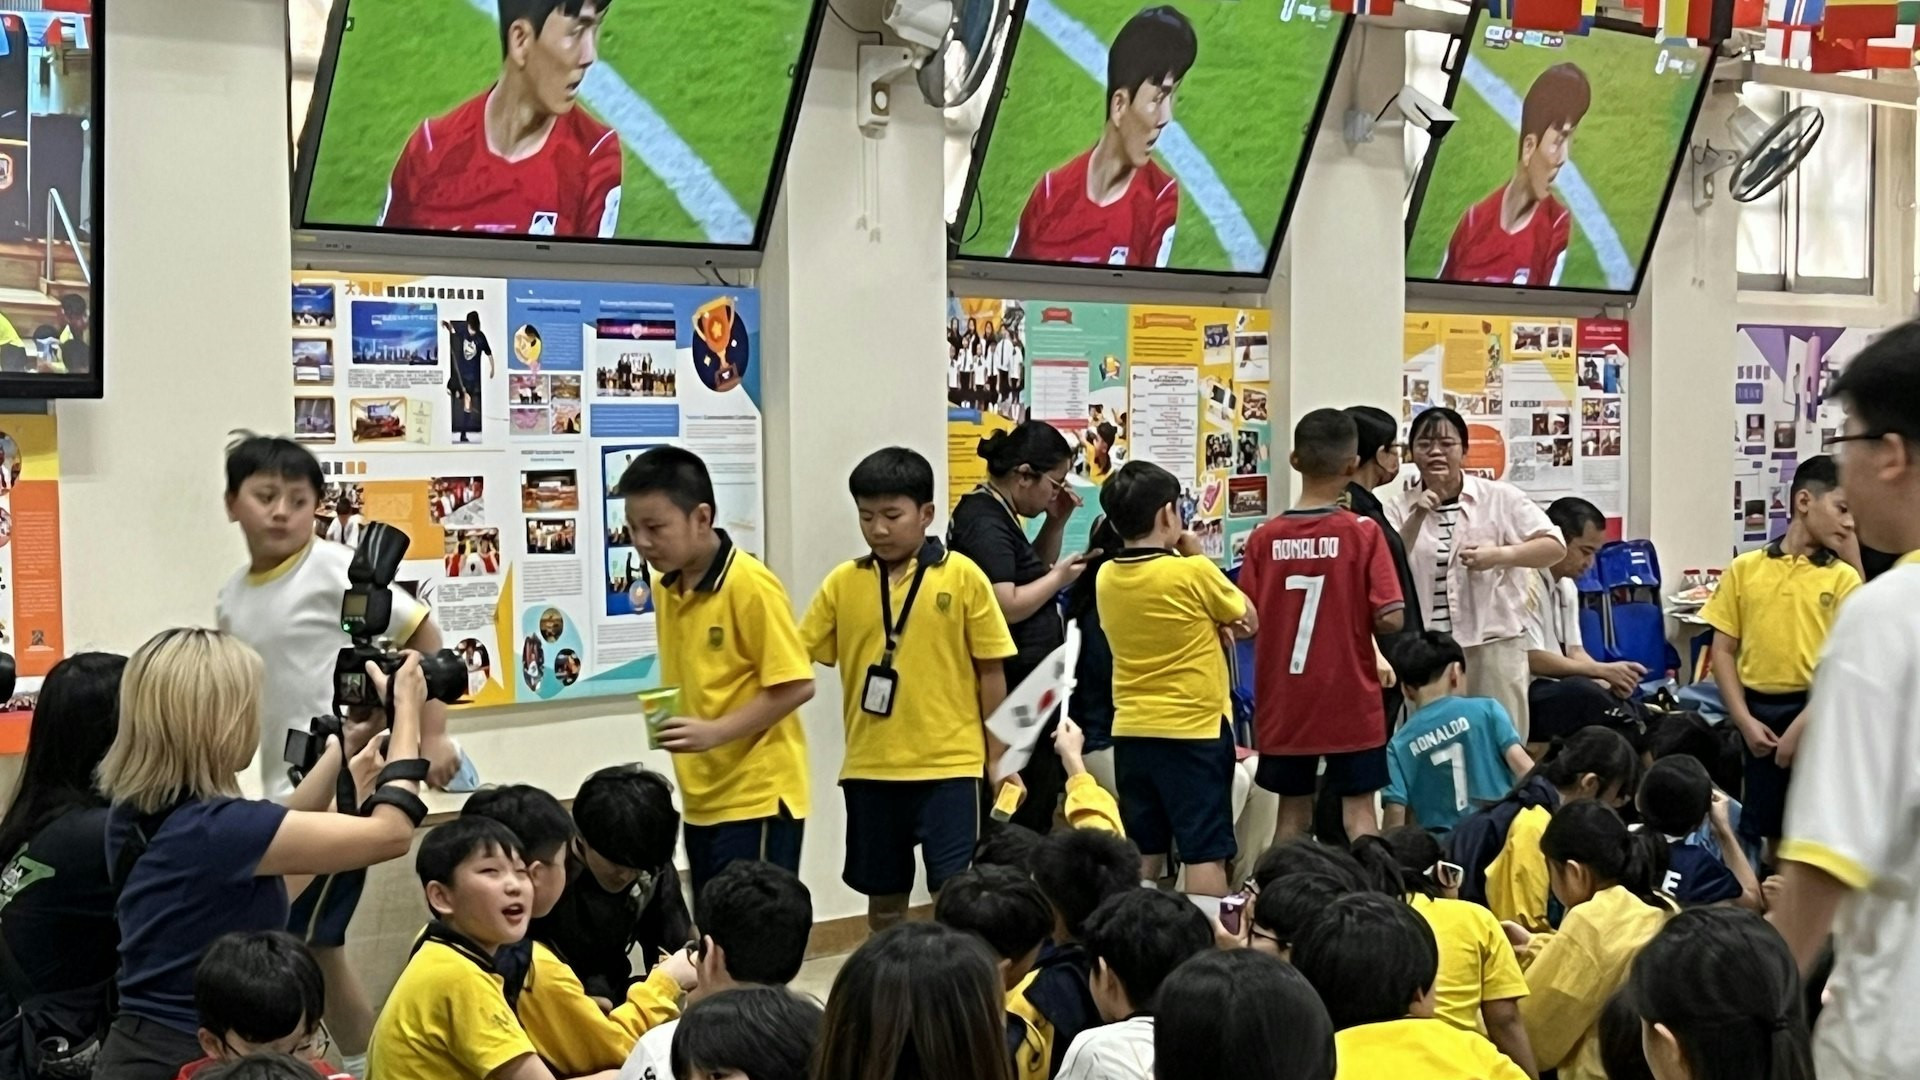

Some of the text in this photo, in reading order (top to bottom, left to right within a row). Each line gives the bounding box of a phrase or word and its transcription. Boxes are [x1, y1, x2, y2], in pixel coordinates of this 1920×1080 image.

[1272, 537, 1339, 560] RONALDO
[1285, 575, 1325, 675] 7
[1409, 717, 1469, 756] RONALDO
[1430, 742, 1468, 811] 7
